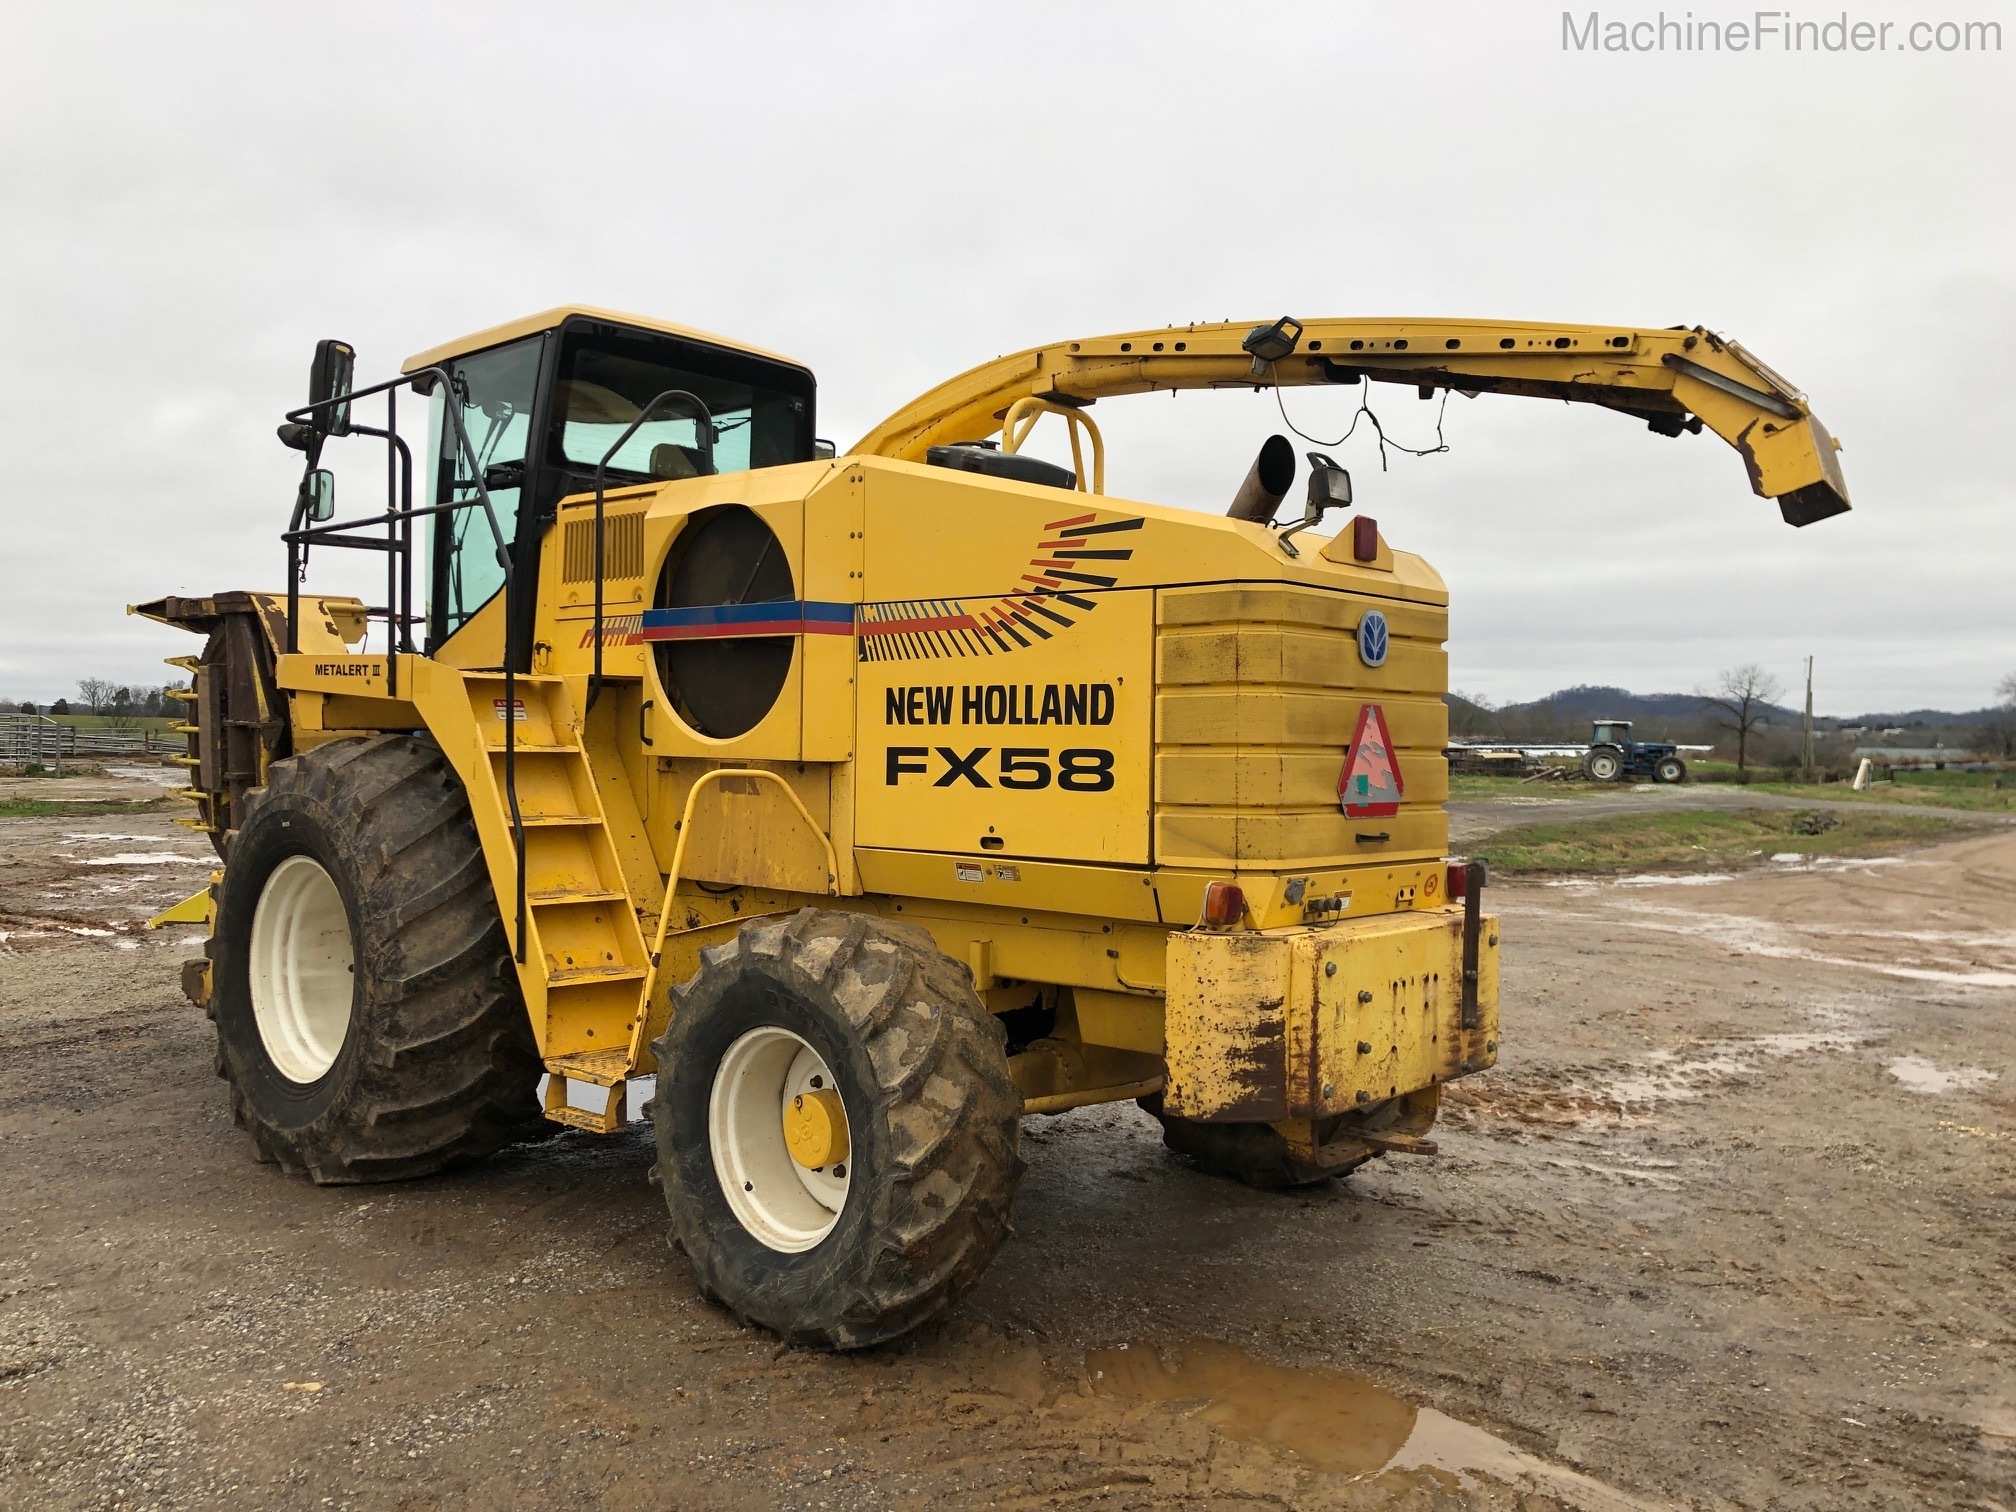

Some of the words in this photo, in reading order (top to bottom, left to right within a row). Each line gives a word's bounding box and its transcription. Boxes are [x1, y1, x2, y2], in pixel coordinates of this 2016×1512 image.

[315, 664, 369, 676] METALERT
[885, 685, 954, 725] NEW
[962, 683, 1114, 725] HOLLAND
[885, 746, 1115, 792] FX58
